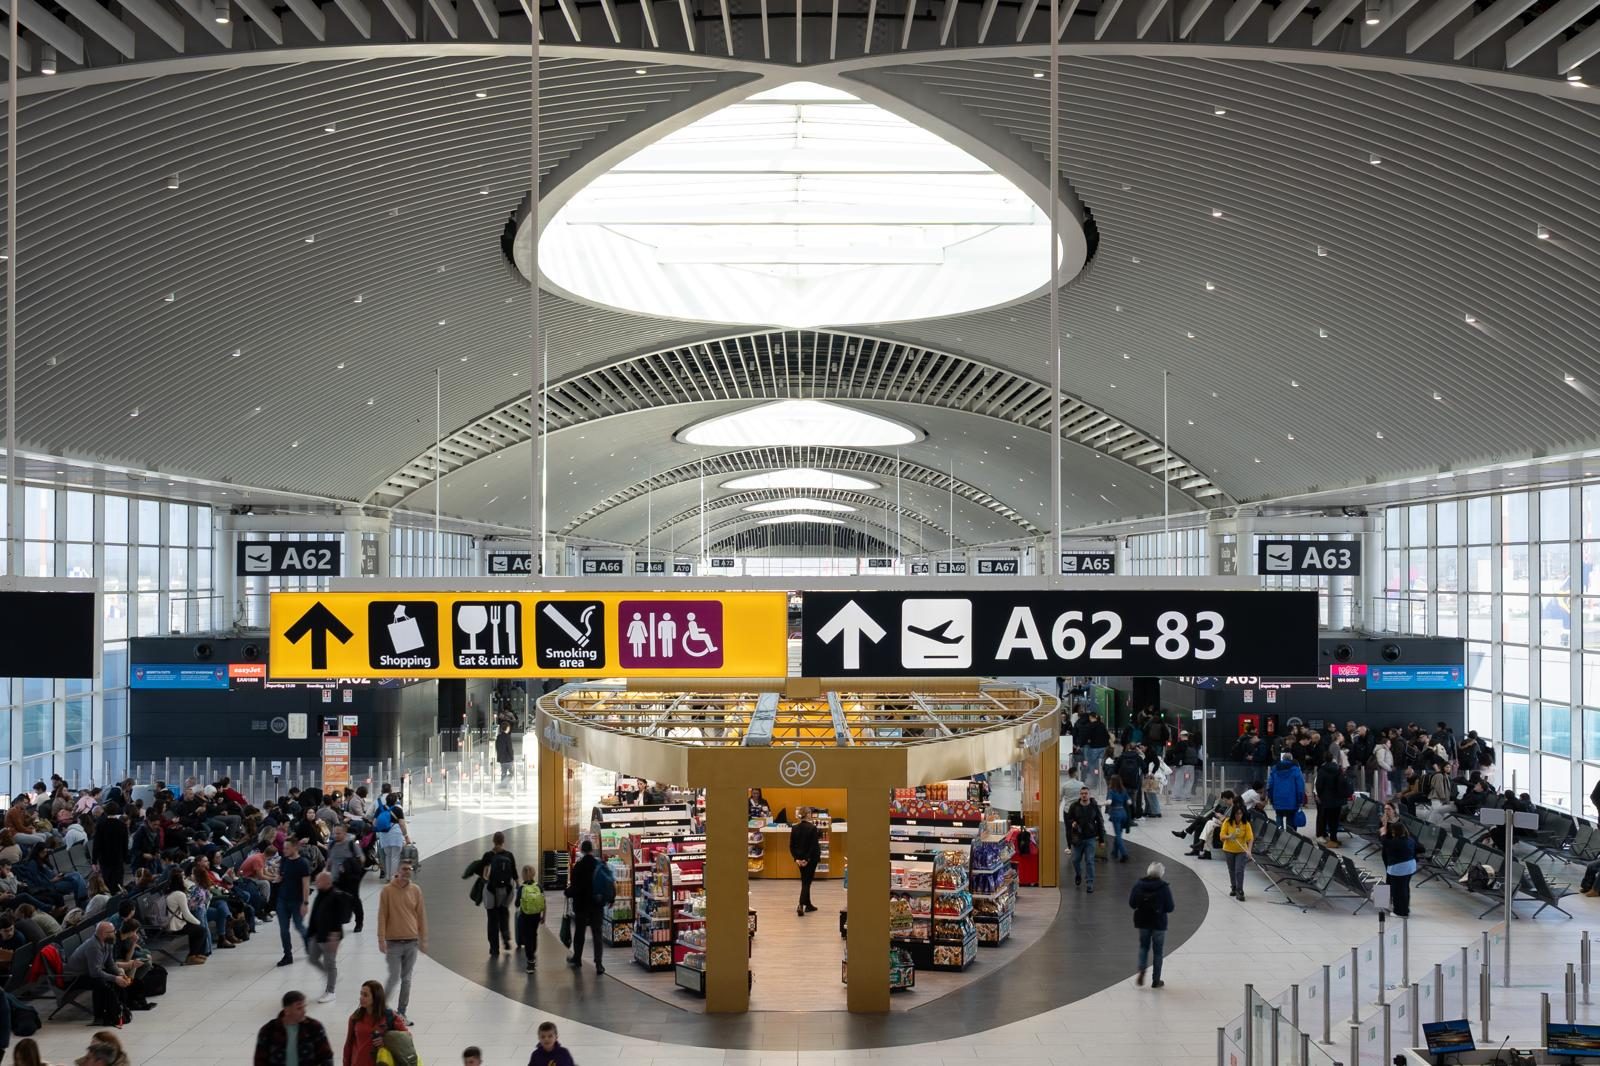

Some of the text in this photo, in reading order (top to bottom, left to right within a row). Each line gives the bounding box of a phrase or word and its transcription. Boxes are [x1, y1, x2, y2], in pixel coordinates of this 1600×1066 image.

[281, 547, 332, 570] A62
[512, 557, 541, 571] A6
[1082, 557, 1110, 570] A65
[1301, 547, 1351, 570] A63
[599, 563, 620, 572] A66
[647, 563, 662, 571] A68
[950, 563, 965, 572] A69
[995, 562, 1015, 572] A67
[995, 605, 1227, 661] A62-83
[459, 655, 519, 666] Eat & drink
[545, 648, 597, 661] Smoking
[380, 655, 431, 668] Shopping
[559, 659, 585, 668] area
[234, 667, 261, 675] easyJet
